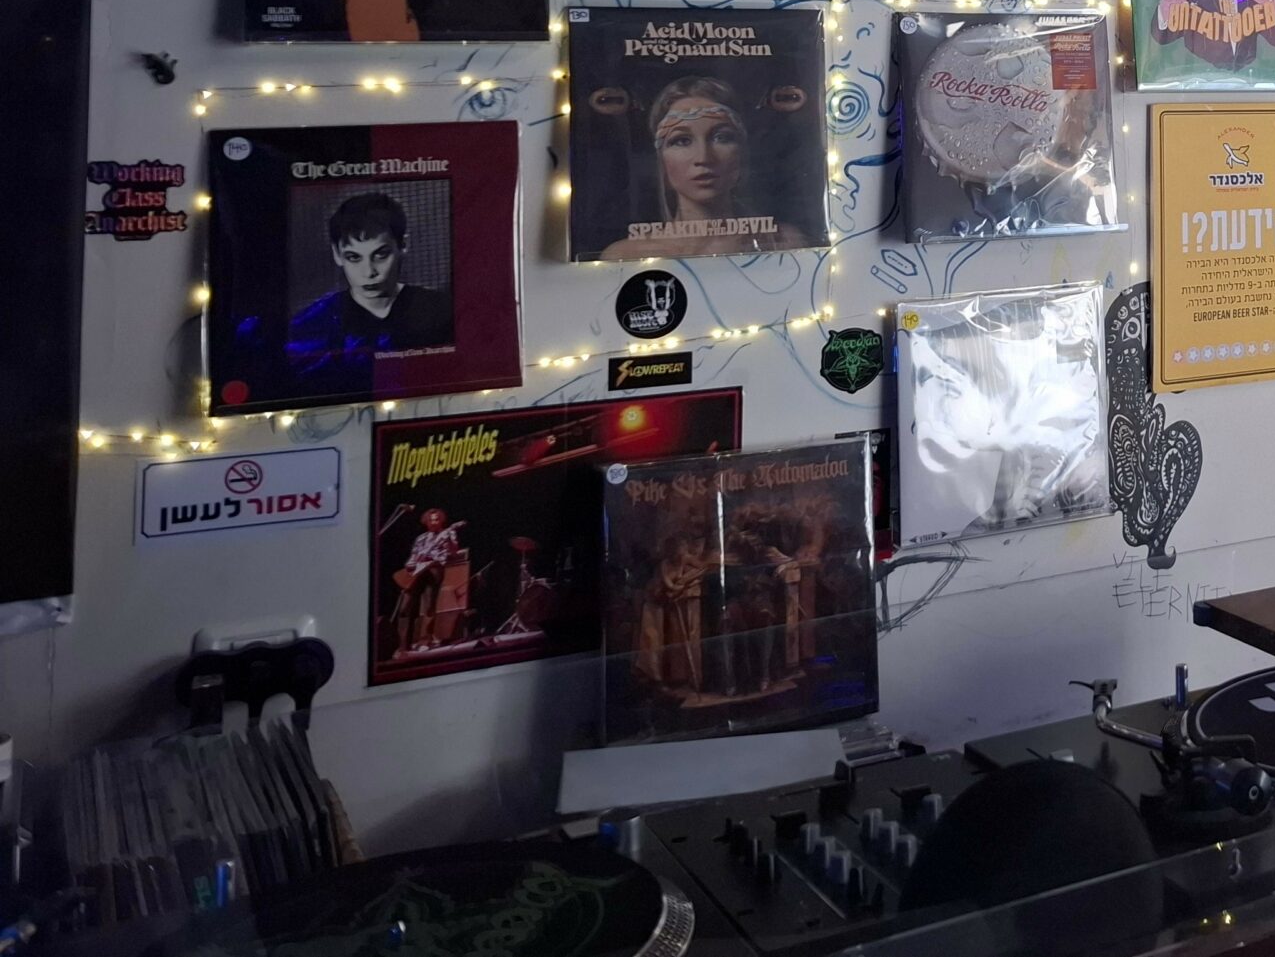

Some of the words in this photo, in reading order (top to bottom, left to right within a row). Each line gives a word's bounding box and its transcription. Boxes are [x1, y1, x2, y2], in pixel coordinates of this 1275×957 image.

[642, 21, 690, 39] Acid
[690, 21, 756, 45] Moon
[624, 39, 729, 65] Pregnant
[729, 40, 773, 57] Sun
[930, 72, 989, 101] Rocka
[989, 85, 1049, 113] Rolla
[89, 162, 185, 186] Working
[291, 160, 326, 180] The
[328, 159, 377, 177] Great
[379, 156, 450, 176] Machine
[1209, 173, 1263, 186] אלכסנדר
[106, 188, 166, 208] Class
[84, 212, 187, 233] Anarchist
[628, 220, 709, 240] SPEAKIN
[726, 216, 778, 235] DEVIL
[1186, 259, 1212, 269] הבירה
[1214, 258, 1229, 267] היא
[1232, 256, 1267, 266] אלכסנדר
[1201, 270, 1231, 280] היחידה
[1232, 267, 1273, 278] הישראלית
[1181, 284, 1214, 294] בתחרות
[1217, 282, 1246, 292] מדליות
[1216, 294, 1242, 305] בעולם
[1244, 293, 1272, 302] נחשבת
[1193, 311, 1231, 322] EUROPEAN
[1232, 309, 1251, 319] BEER
[616, 359, 686, 389] SLOWREPEAT
[387, 423, 499, 489] Mephistofeles
[247, 491, 322, 515] אסור
[626, 479, 668, 507] Pike
[159, 498, 241, 531] לעשן
